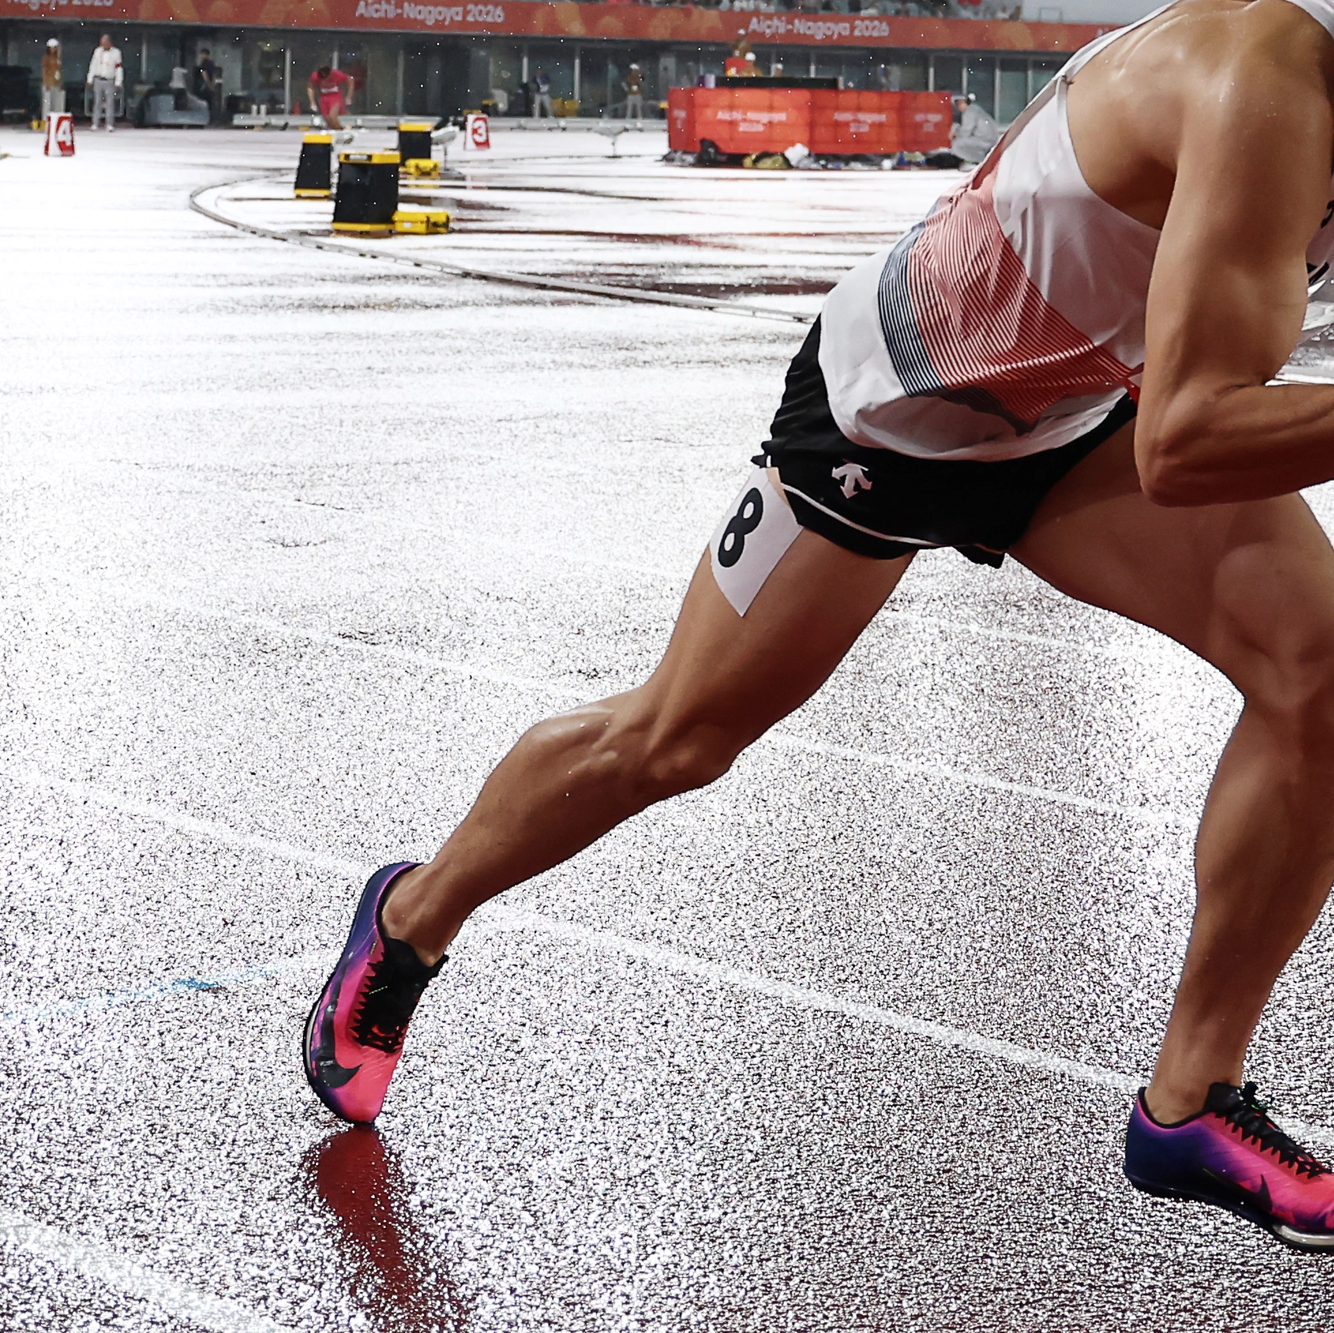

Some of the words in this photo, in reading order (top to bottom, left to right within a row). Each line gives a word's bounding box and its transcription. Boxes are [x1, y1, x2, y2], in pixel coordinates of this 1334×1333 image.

[355, 0, 463, 26] Aichi-Nagoya
[466, 4, 505, 23] 2026
[748, 16, 850, 40] Aichi-Nagoya
[853, 19, 890, 37] 2026
[57, 119, 72, 146] 4
[472, 117, 488, 143] 3
[718, 487, 764, 568] 8
